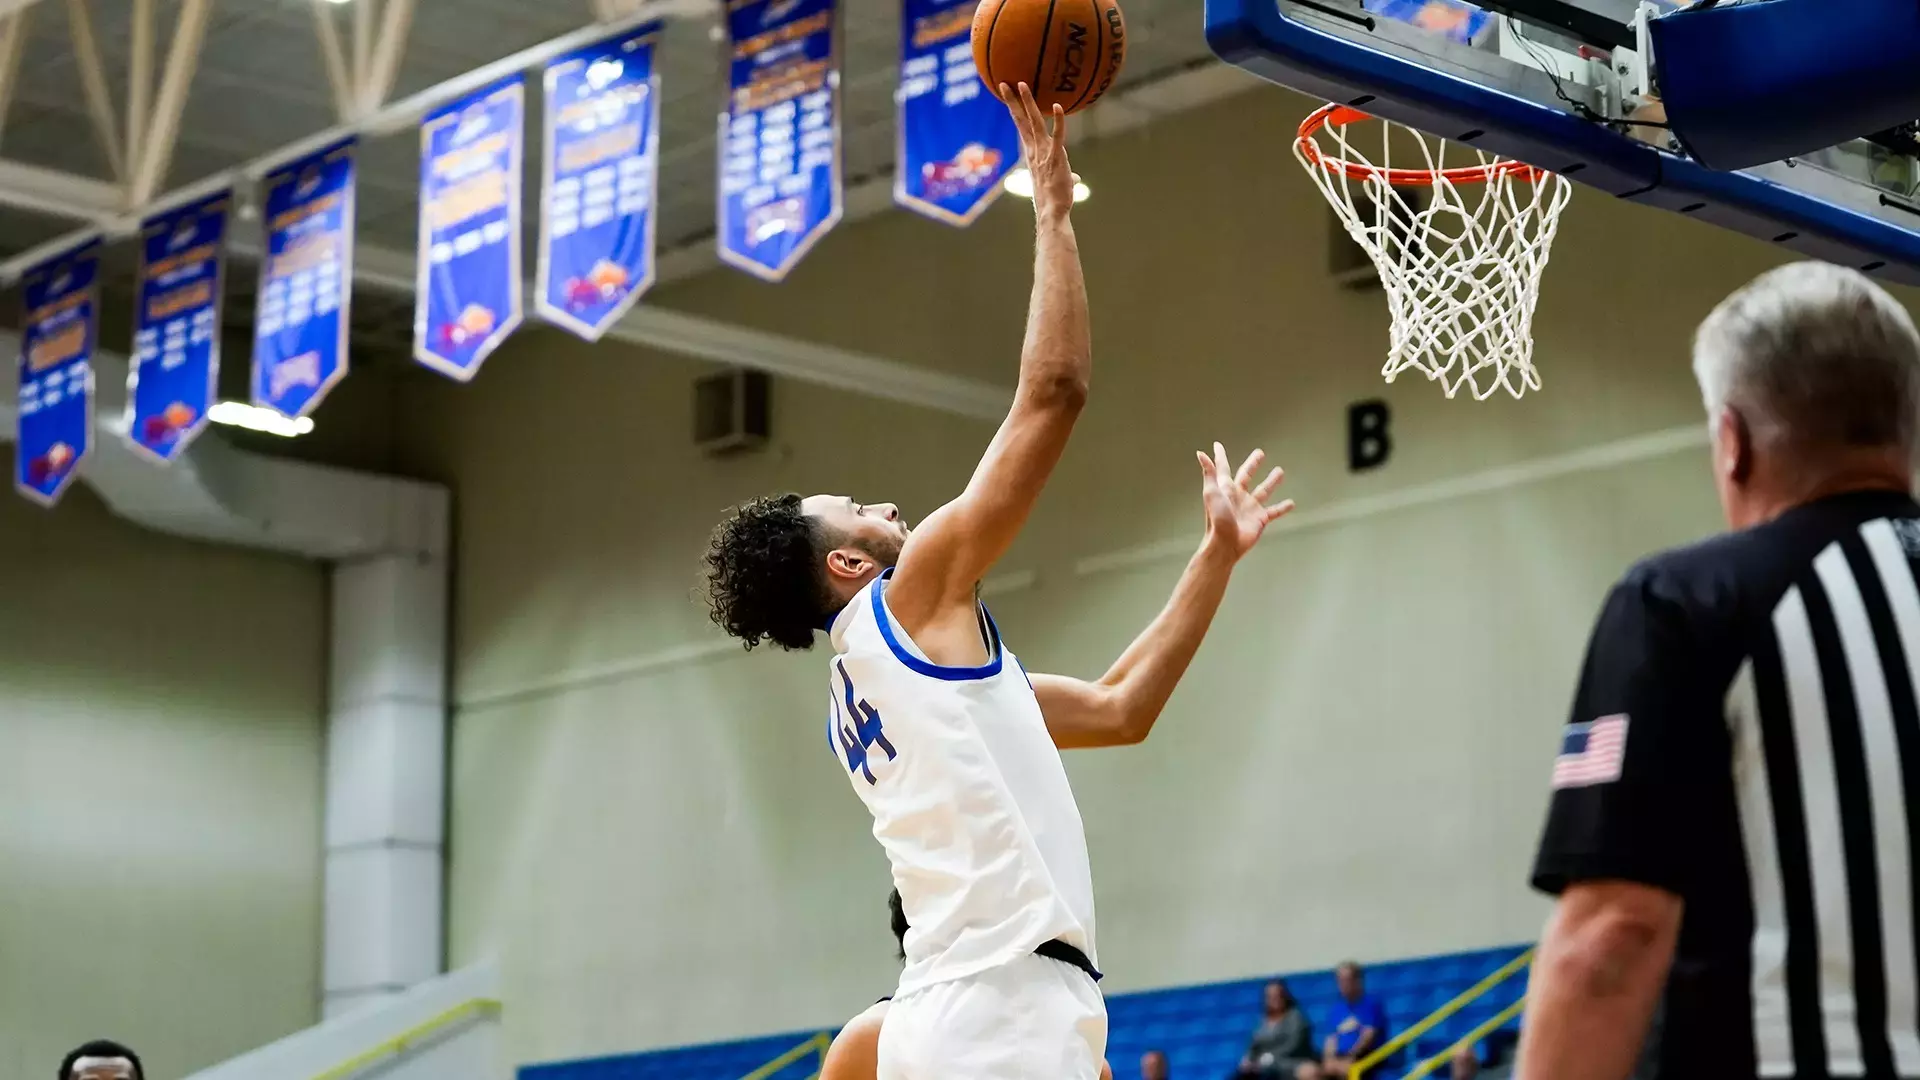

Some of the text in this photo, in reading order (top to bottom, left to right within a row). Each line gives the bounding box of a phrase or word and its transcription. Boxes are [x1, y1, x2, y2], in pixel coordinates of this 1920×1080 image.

[1055, 22, 1087, 92] NCAA
[1347, 401, 1392, 473] B
[830, 658, 897, 786] 44
